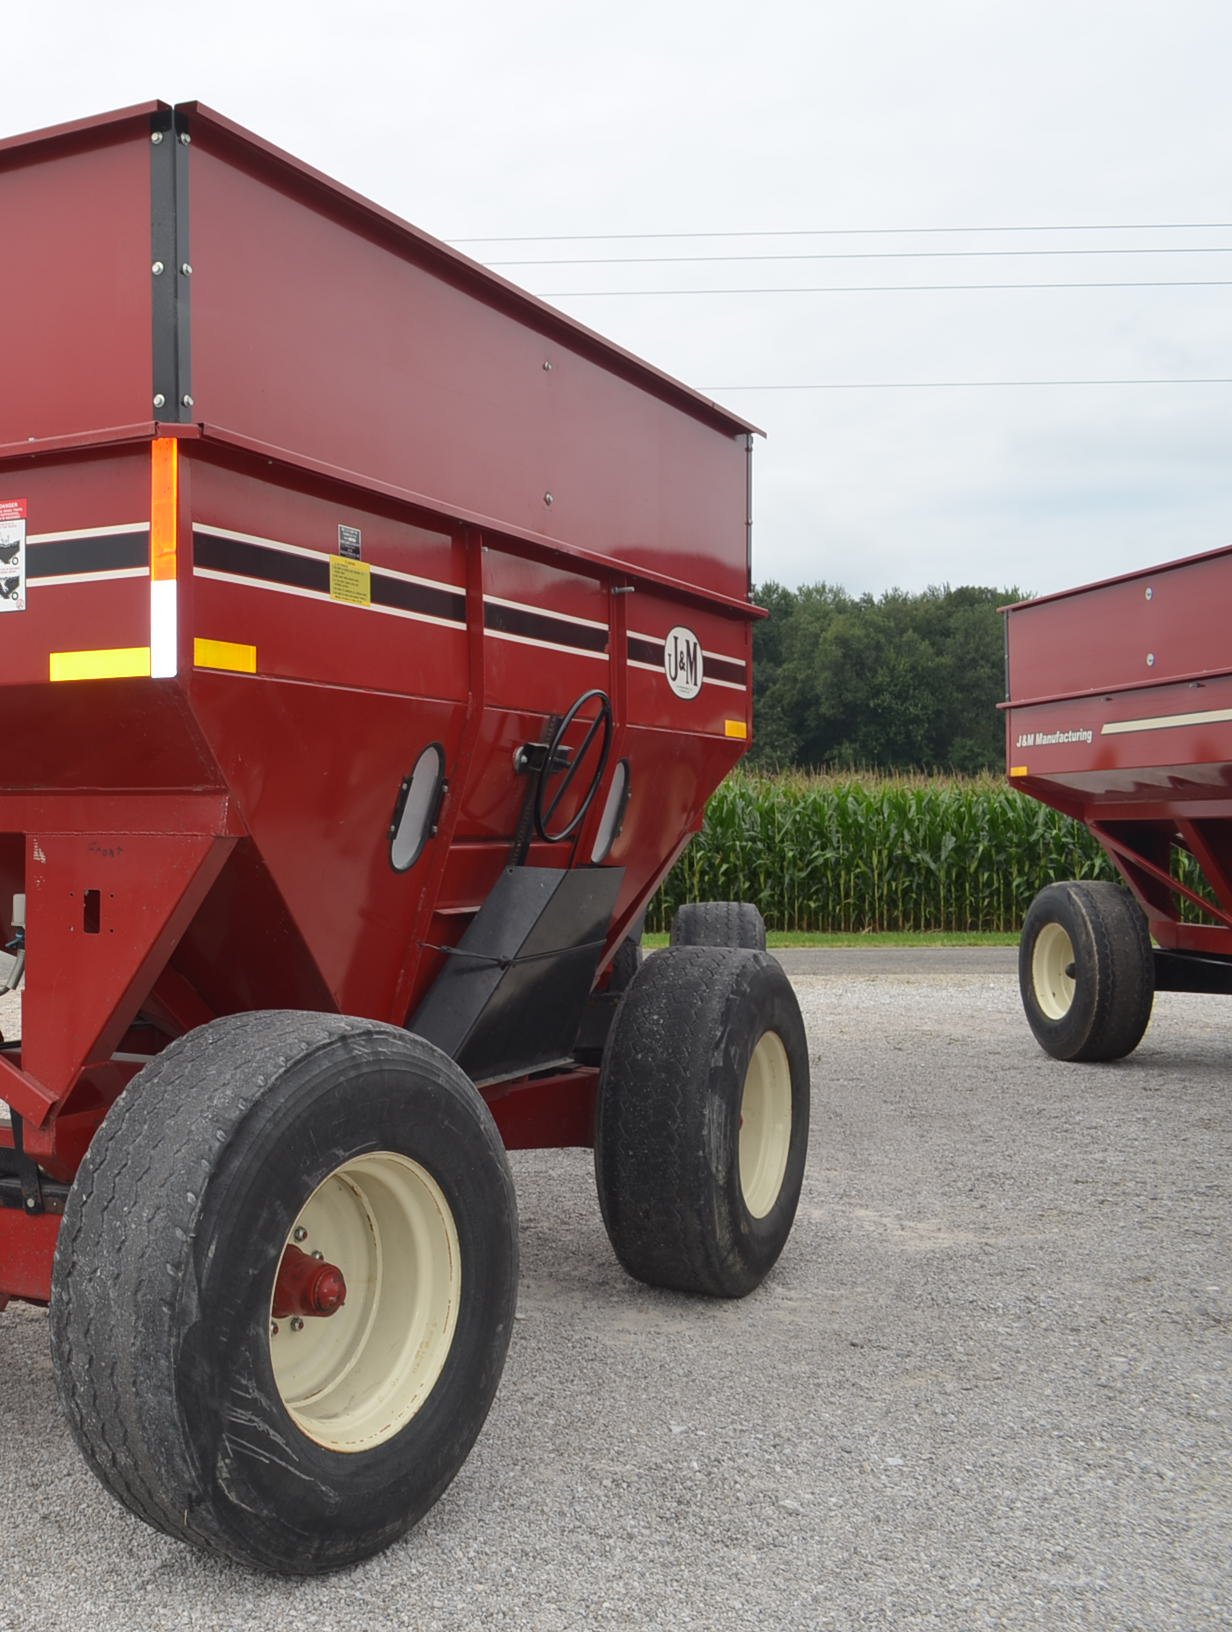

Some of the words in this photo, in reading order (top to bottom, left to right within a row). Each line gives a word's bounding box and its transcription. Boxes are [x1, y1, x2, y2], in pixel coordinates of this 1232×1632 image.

[667, 635, 698, 687] J&M
[1016, 733, 1035, 748] J&M
[1035, 728, 1093, 746] Manufacturing
